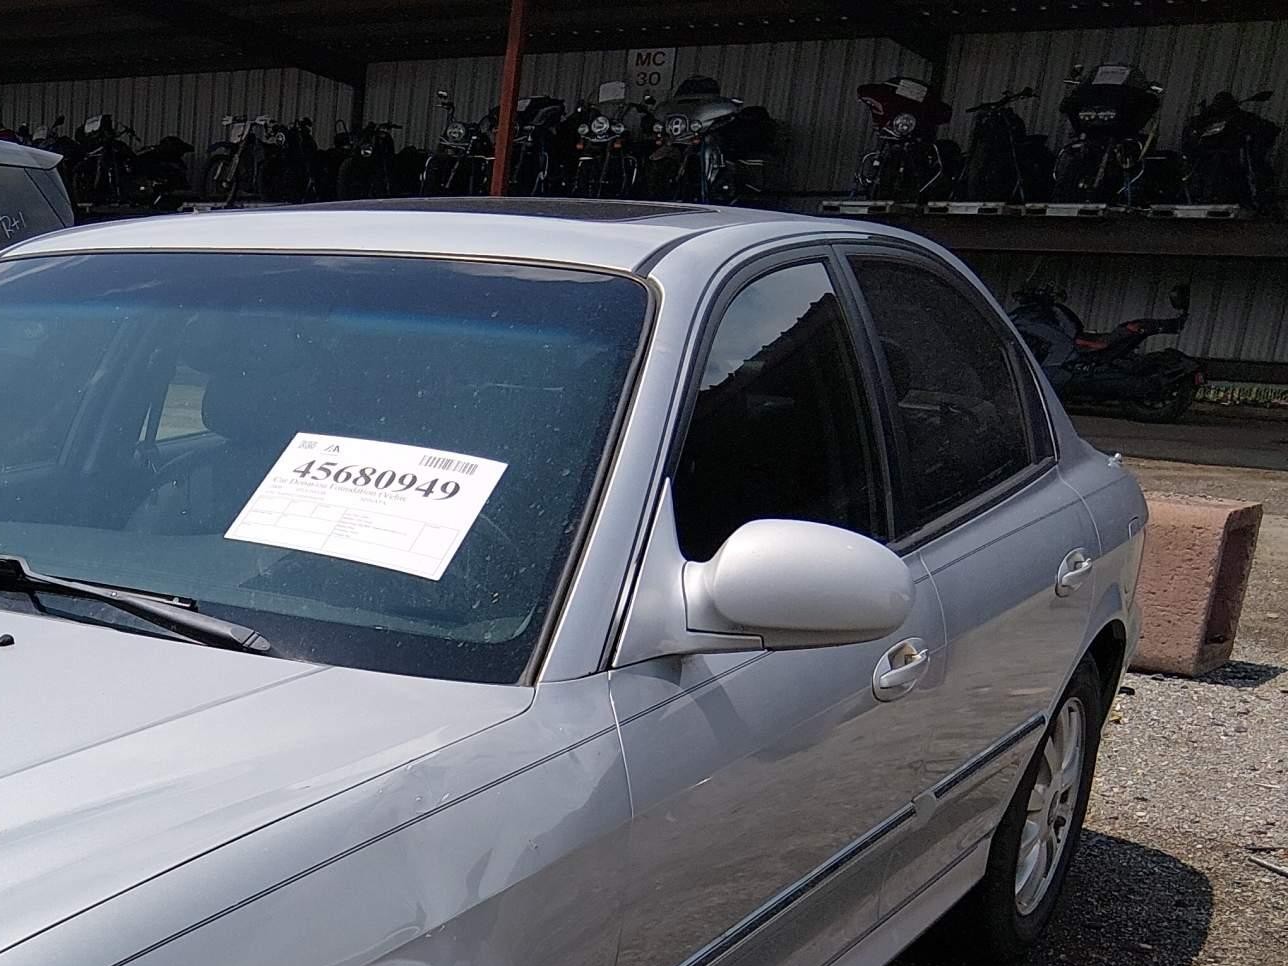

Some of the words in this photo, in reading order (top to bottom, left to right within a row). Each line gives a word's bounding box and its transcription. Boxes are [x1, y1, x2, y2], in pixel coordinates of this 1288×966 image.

[635, 51, 666, 67] MC
[636, 71, 661, 86] 30
[292, 459, 460, 500] 45680949
